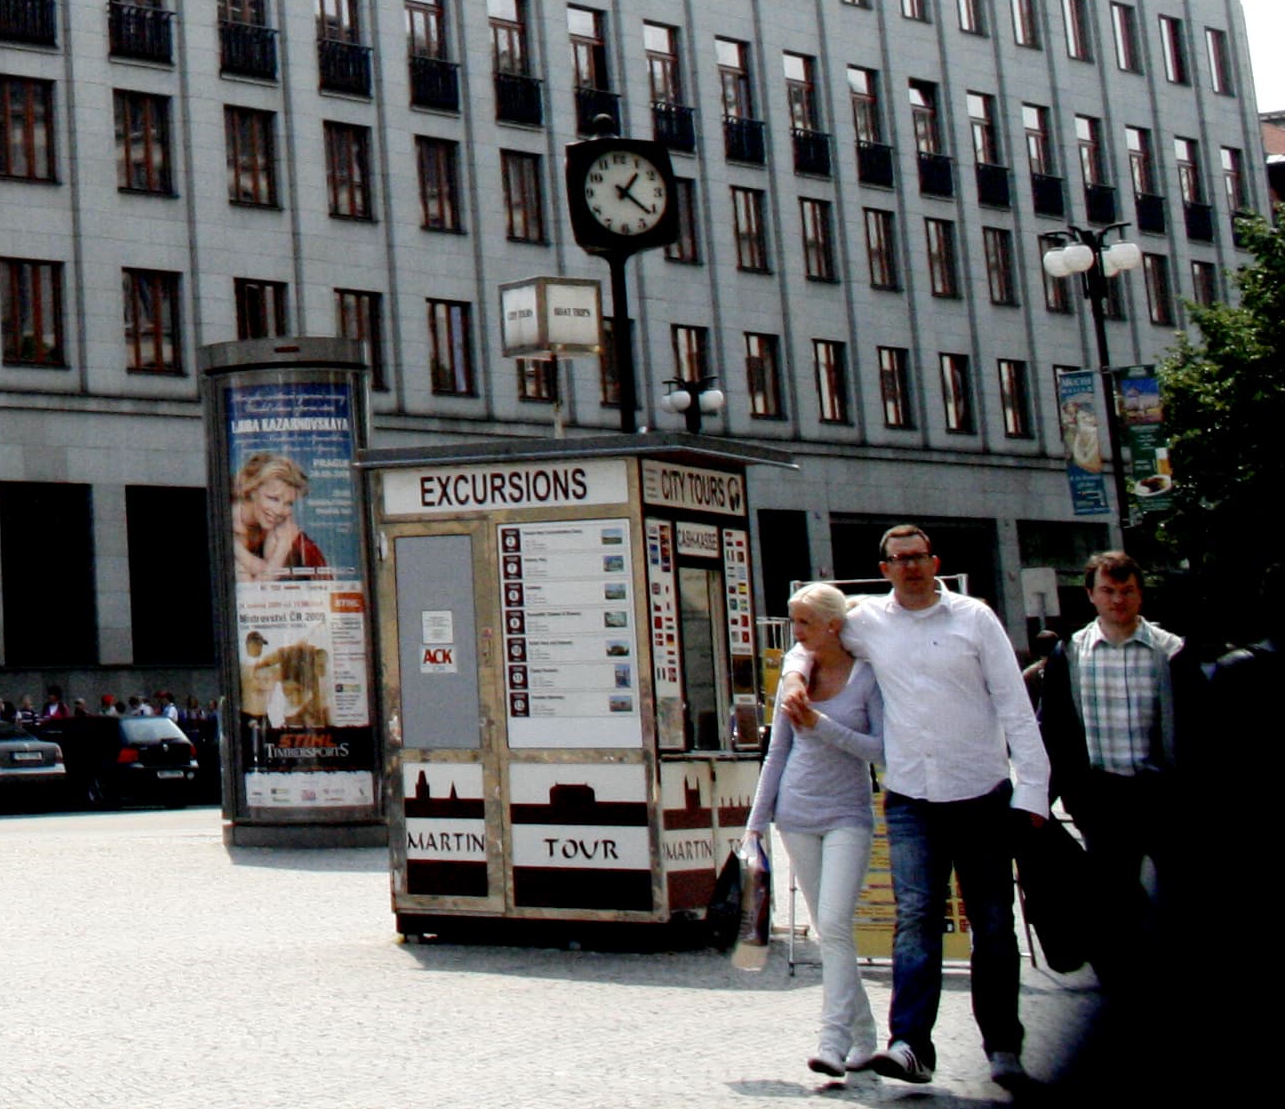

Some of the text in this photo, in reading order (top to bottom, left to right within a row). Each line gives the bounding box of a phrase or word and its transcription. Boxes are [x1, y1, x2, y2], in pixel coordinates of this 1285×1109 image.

[420, 468, 588, 507] EXCURSIONS
[661, 469, 685, 502] CITY
[687, 473, 725, 507] TOURS
[407, 831, 620, 860] MARTIN TOUR
[662, 840, 713, 861] MARTIN
